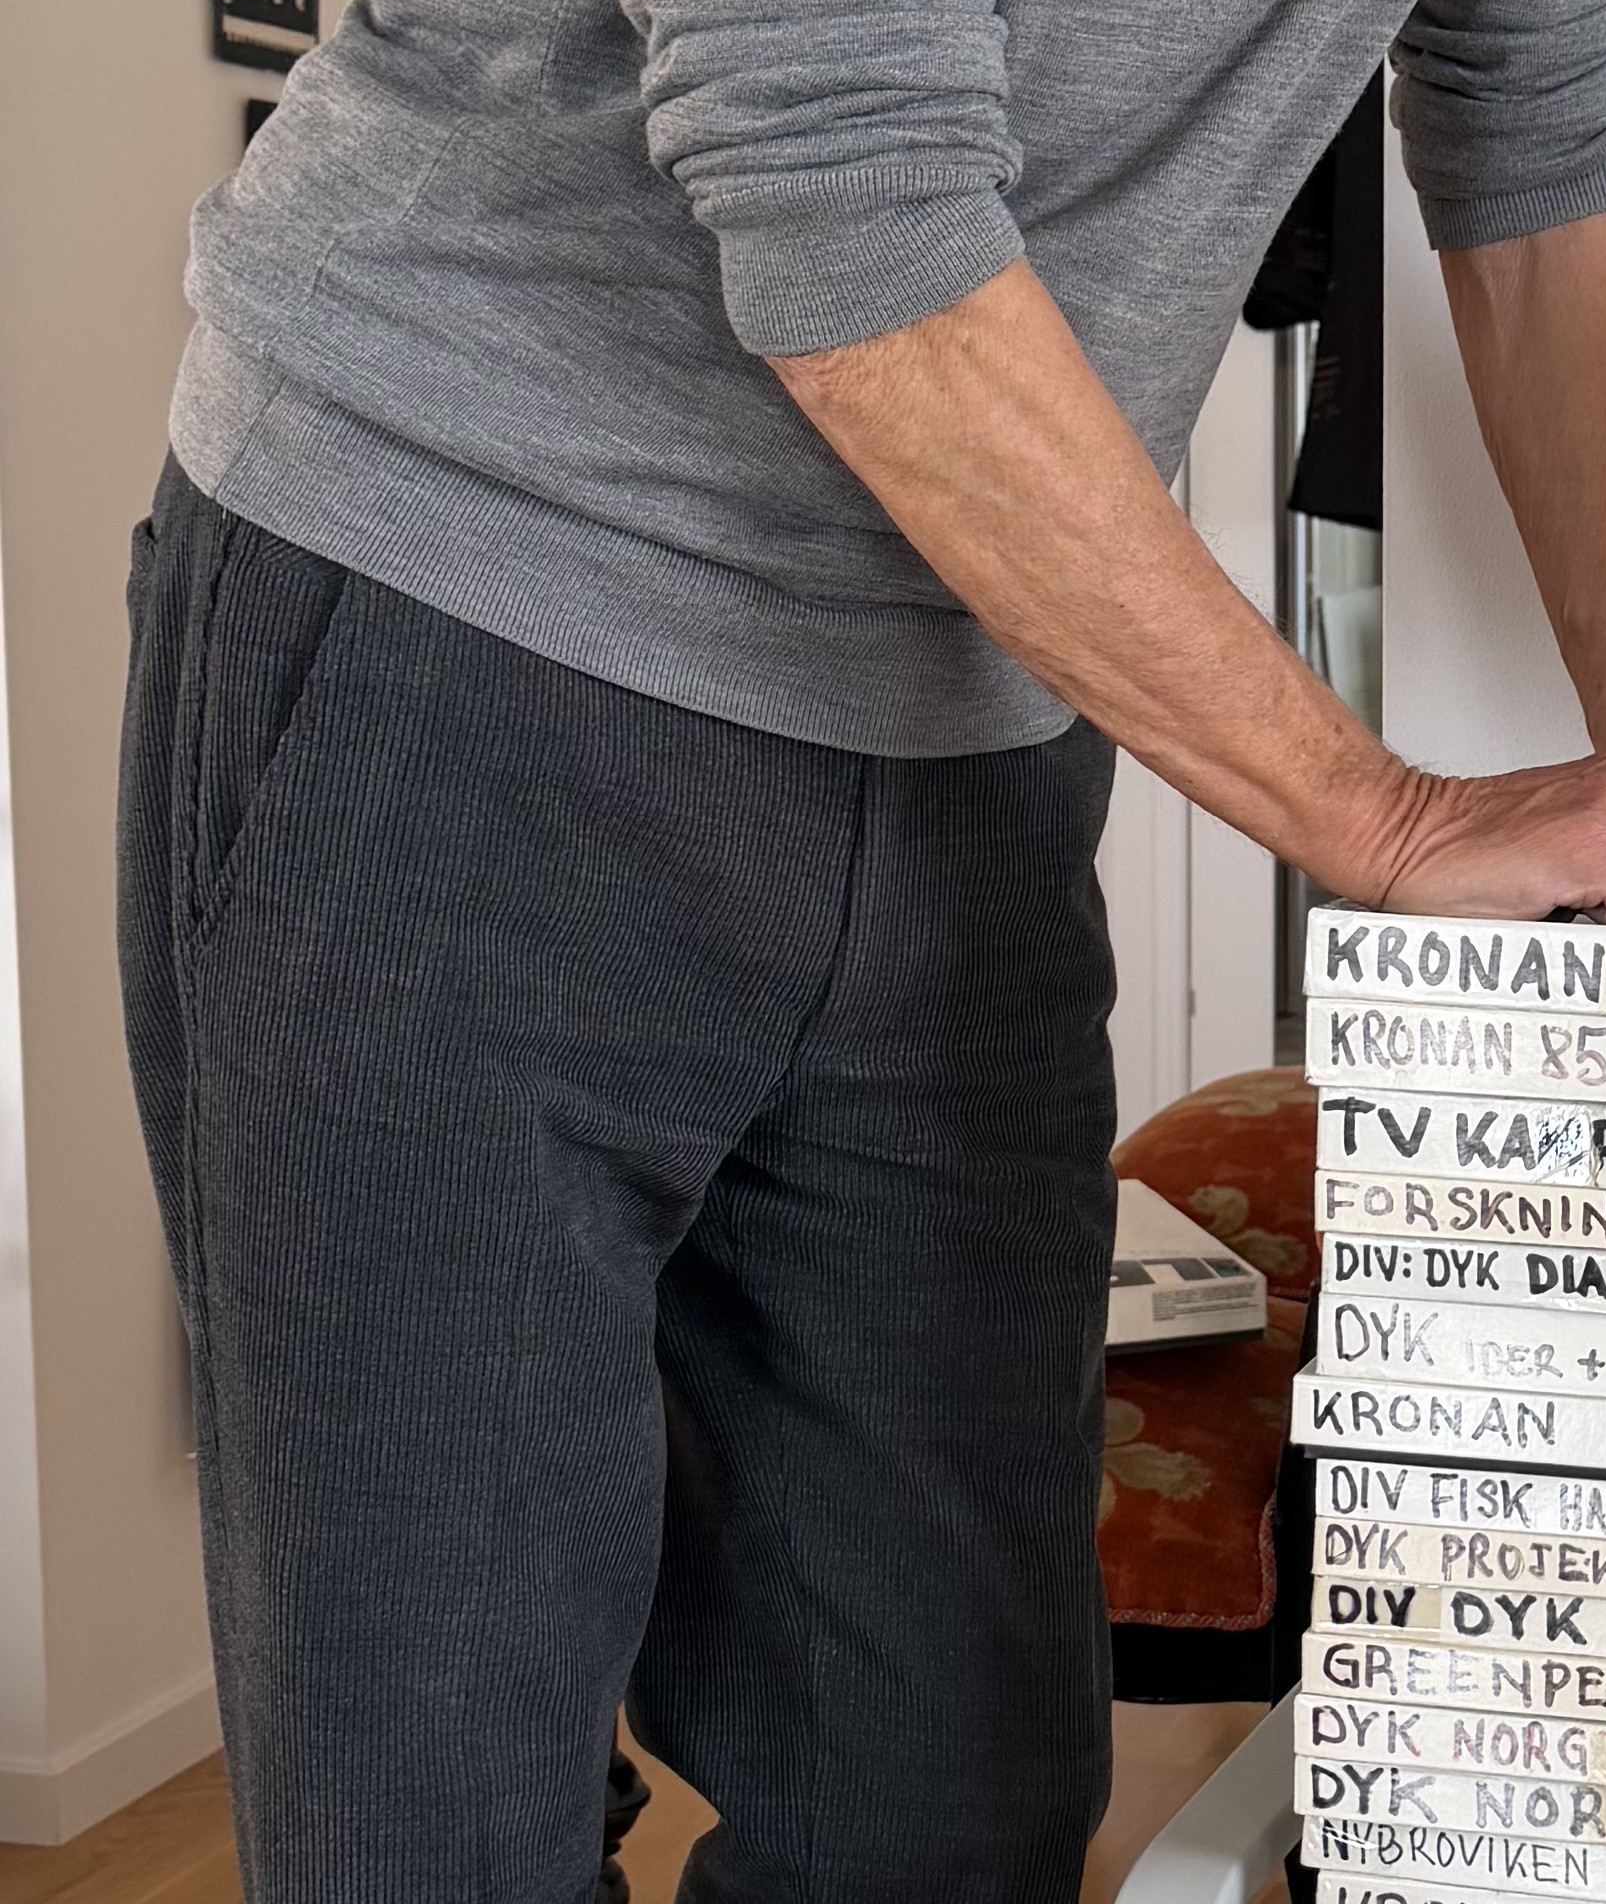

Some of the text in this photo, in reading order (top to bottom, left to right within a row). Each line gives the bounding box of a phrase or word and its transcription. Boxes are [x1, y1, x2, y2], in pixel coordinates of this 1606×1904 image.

[1326, 925, 1606, 1003] KRONAN
[1330, 1008, 1513, 1077] KRONAN
[1321, 1096, 1432, 1159] TV
[1423, 1246, 1501, 1292] DYK
[1334, 1302, 1440, 1368] DYK
[1312, 1388, 1557, 1449] KRONAN
[1330, 1464, 1409, 1515] DIV
[1430, 1472, 1534, 1530] FISK
[1324, 1522, 1409, 1577] DYK
[1449, 1590, 1588, 1645] DYK
[1310, 1704, 1423, 1758] DYK
[1310, 1763, 1439, 1824] DYK
